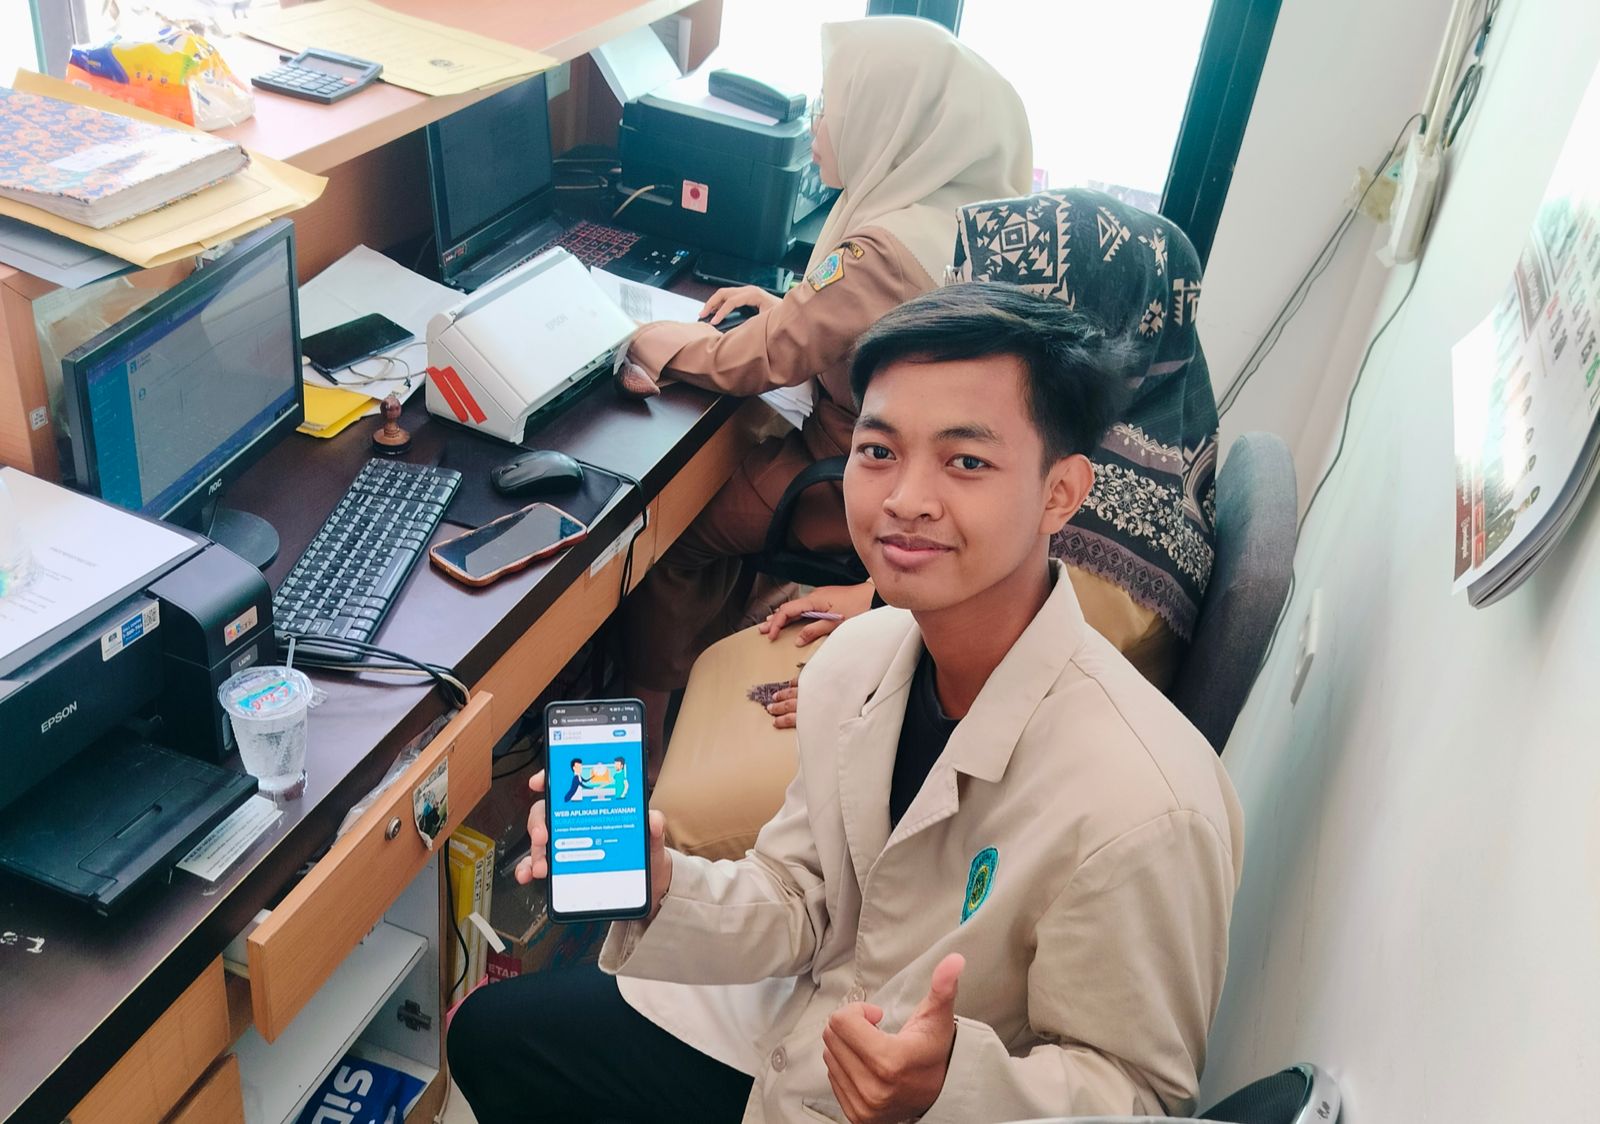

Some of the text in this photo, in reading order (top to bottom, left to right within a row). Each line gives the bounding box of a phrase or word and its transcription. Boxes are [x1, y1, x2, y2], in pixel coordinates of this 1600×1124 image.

[41, 700, 78, 733] EPSON
[570, 809, 599, 817] APLIKASI
[599, 807, 636, 816] PELAYANAN
